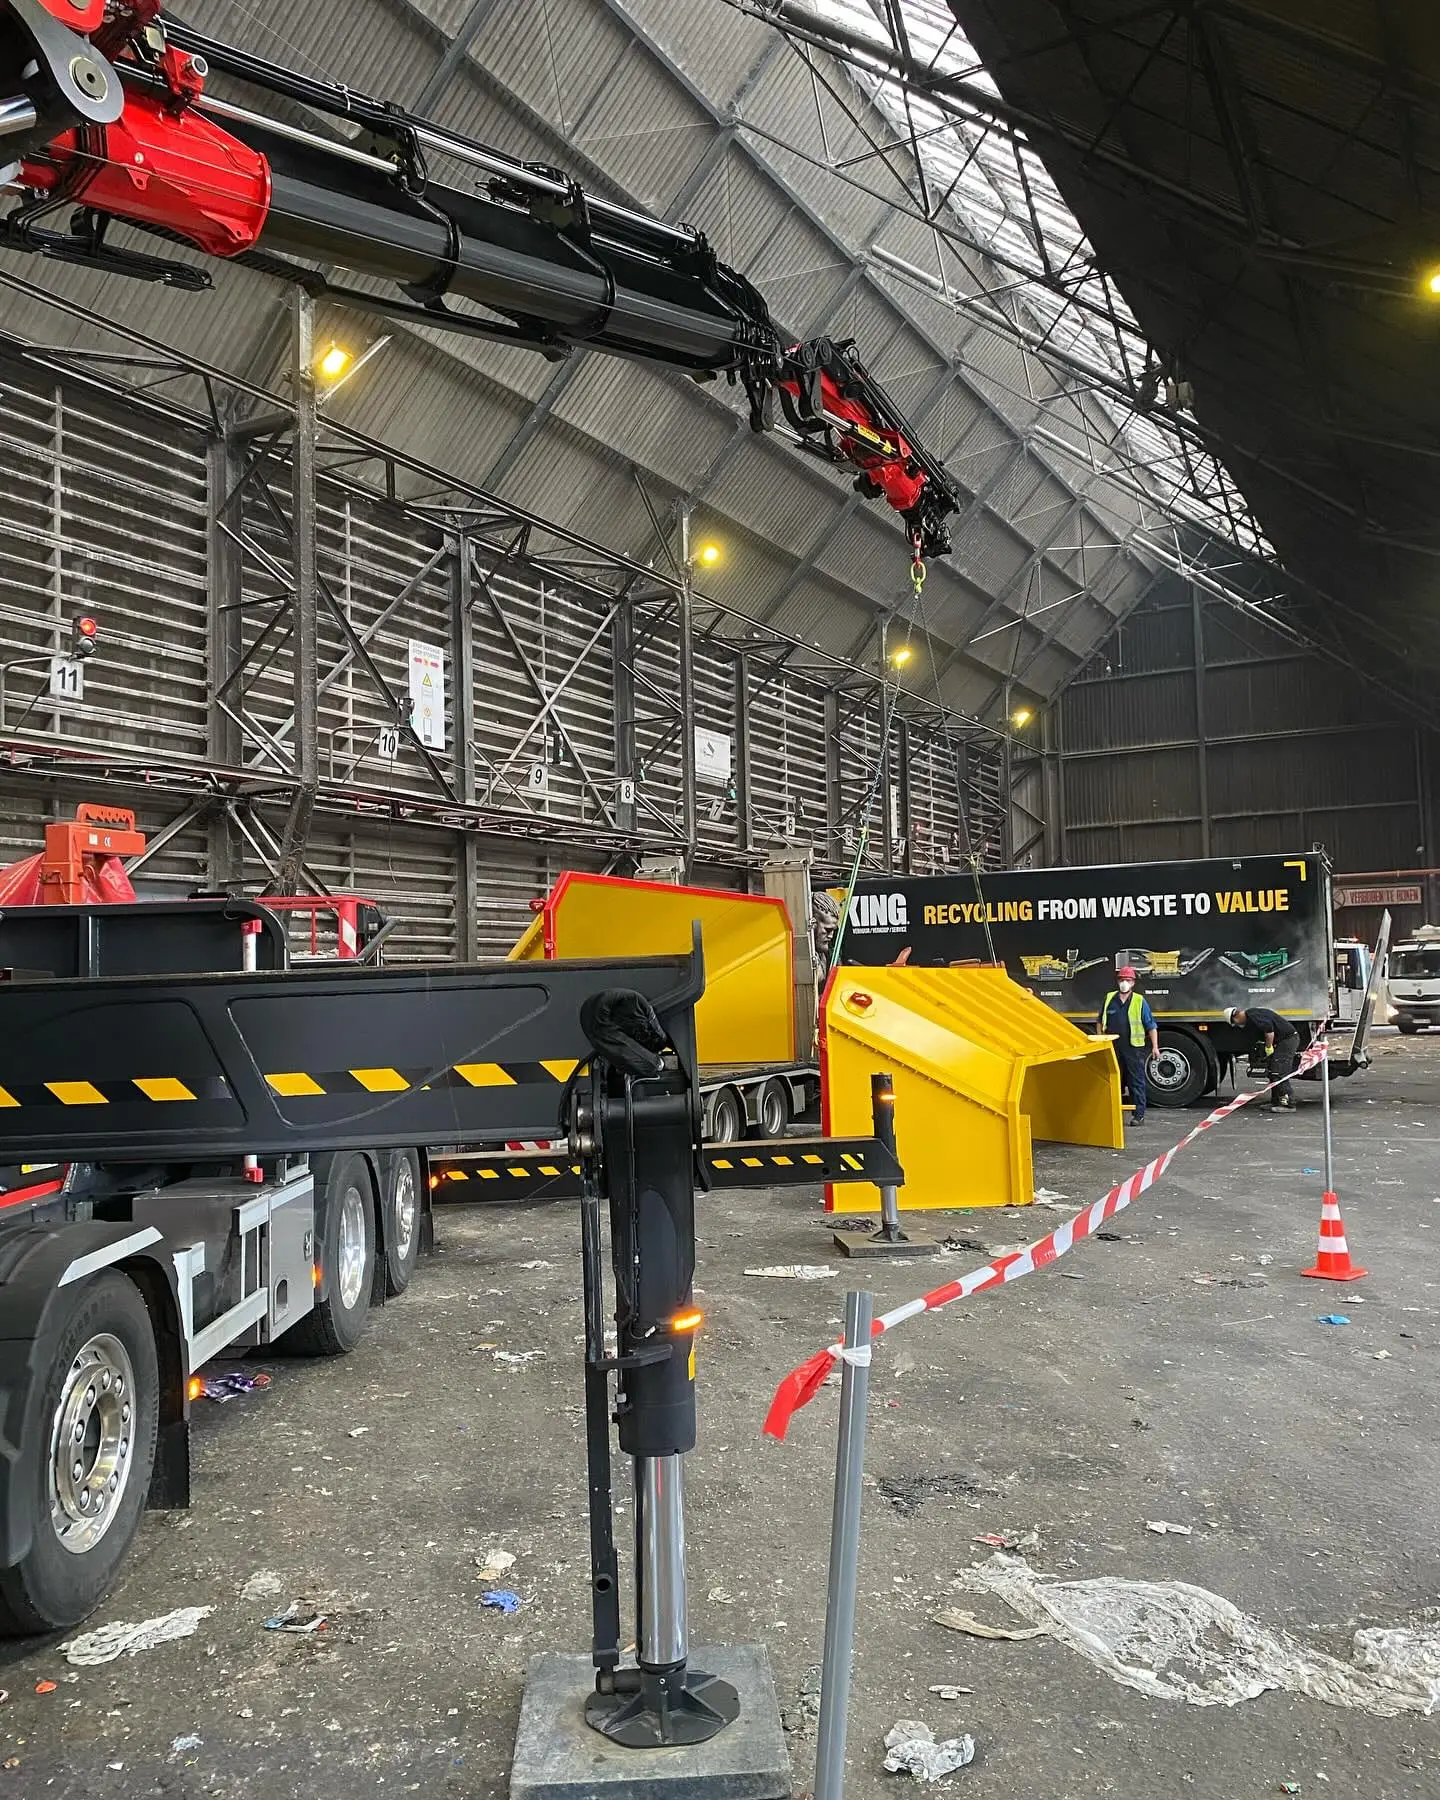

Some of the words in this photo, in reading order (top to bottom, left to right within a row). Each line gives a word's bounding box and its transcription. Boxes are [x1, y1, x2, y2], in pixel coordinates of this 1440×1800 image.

[57, 666, 77, 692] 11
[381, 733, 396, 753] 10
[534, 768, 543, 785] 9
[624, 784, 631, 799] 8
[713, 804, 721, 817] 7
[787, 819, 793, 831] 6
[923, 900, 1033, 925] RECYCLING
[1038, 897, 1097, 921] FROM
[1102, 894, 1178, 918] WASTE
[1181, 892, 1211, 915] TO
[1215, 889, 1289, 913] VALUE
